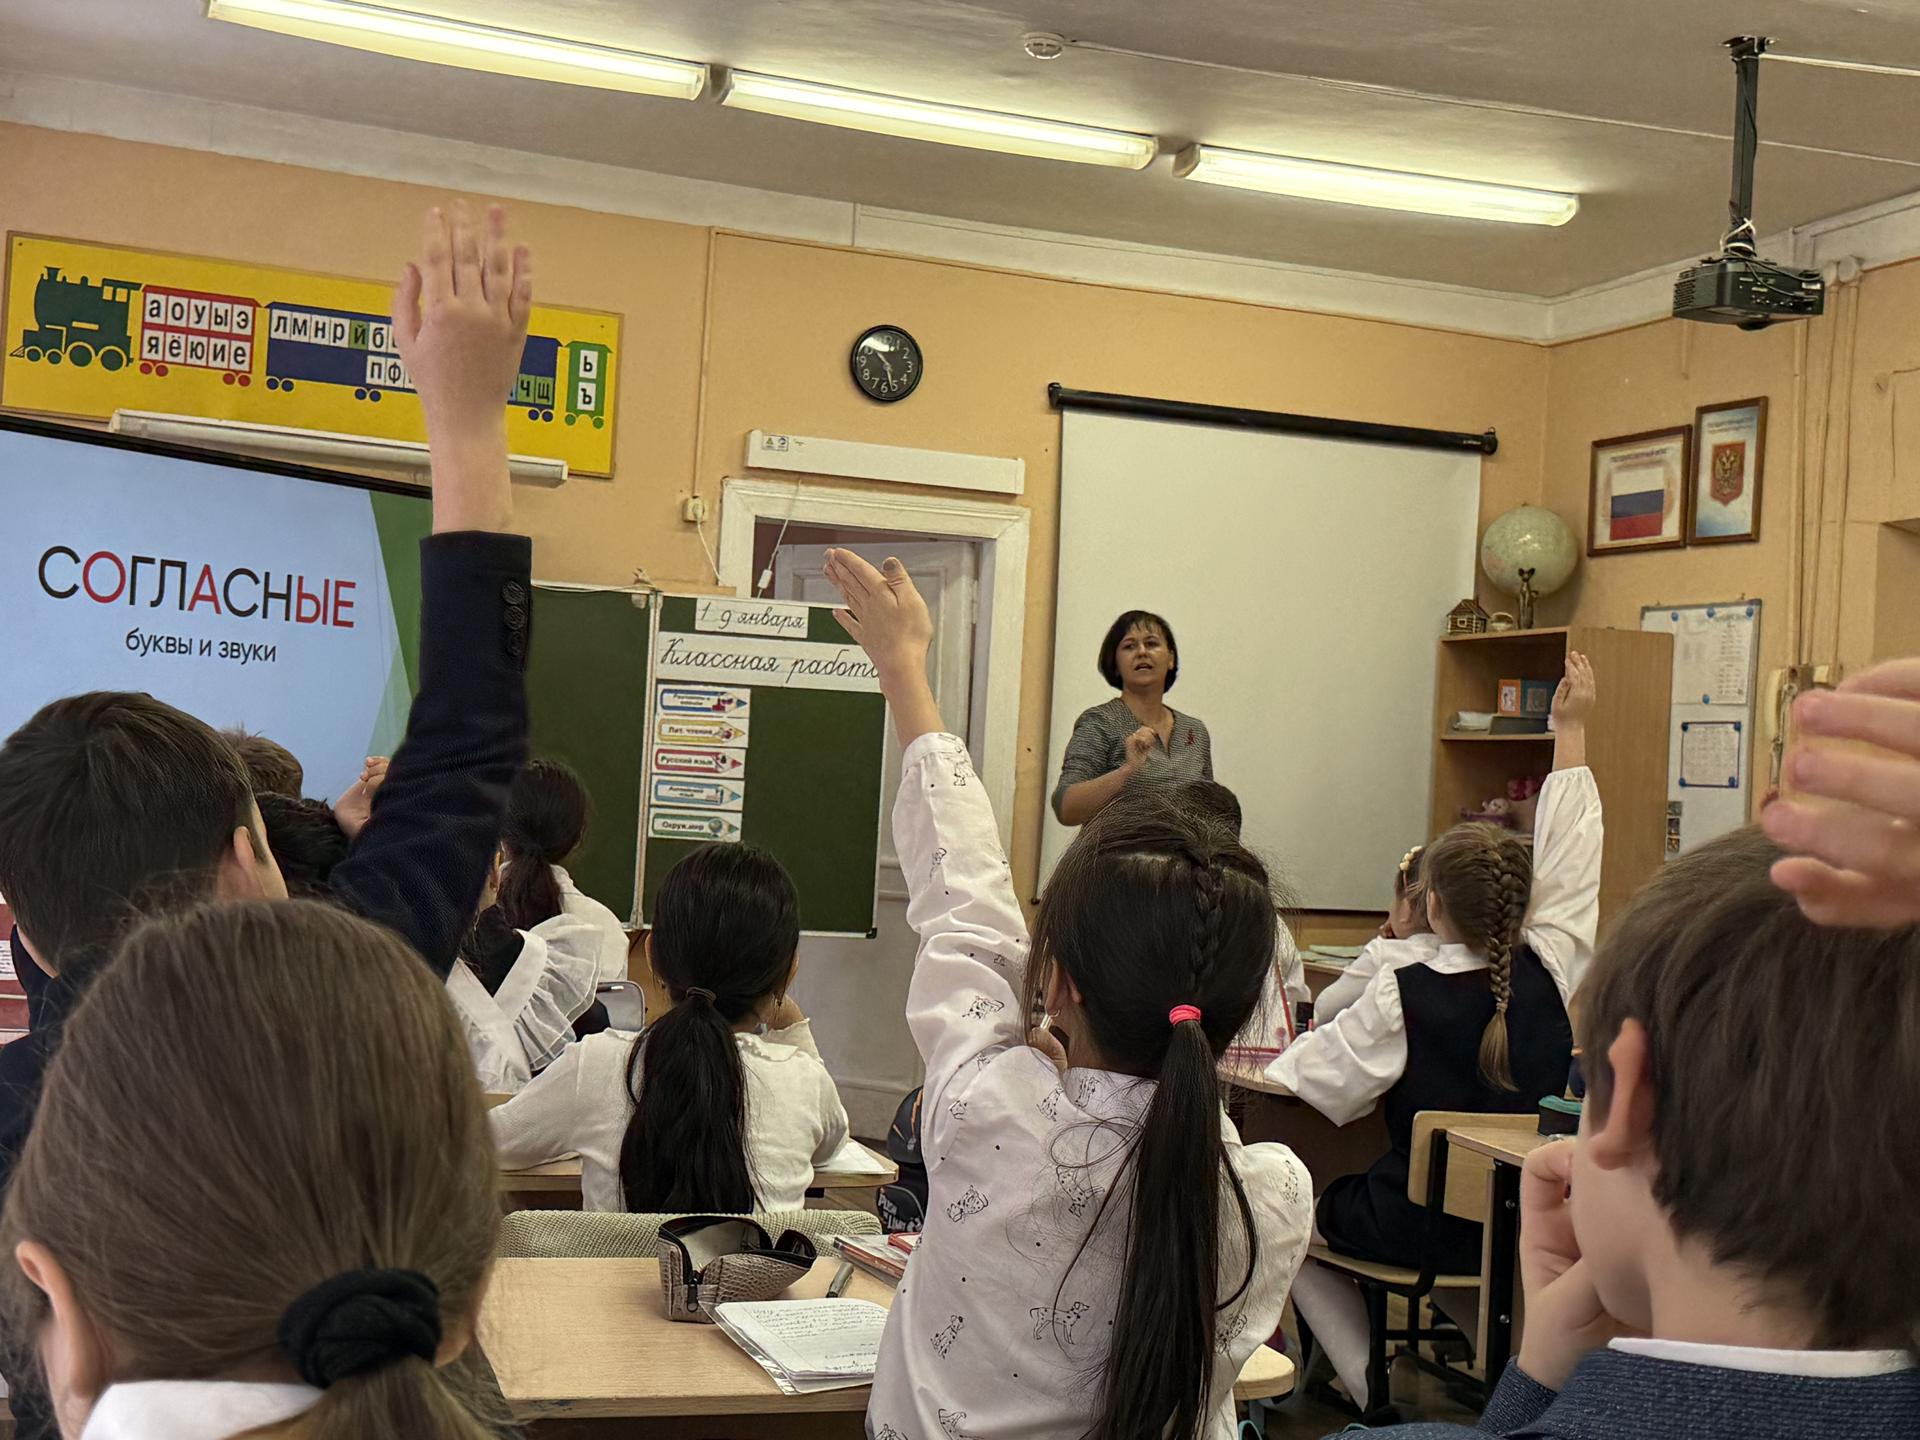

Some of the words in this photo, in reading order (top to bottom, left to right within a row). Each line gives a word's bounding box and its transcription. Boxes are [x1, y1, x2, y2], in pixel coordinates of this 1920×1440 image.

[38, 545, 357, 628] СОГЛАСНЫЕ
[737, 606, 805, 634] января
[125, 627, 192, 657] буквы
[199, 639, 212, 656] и
[218, 640, 277, 665] звуки
[660, 638, 780, 672] Классная
